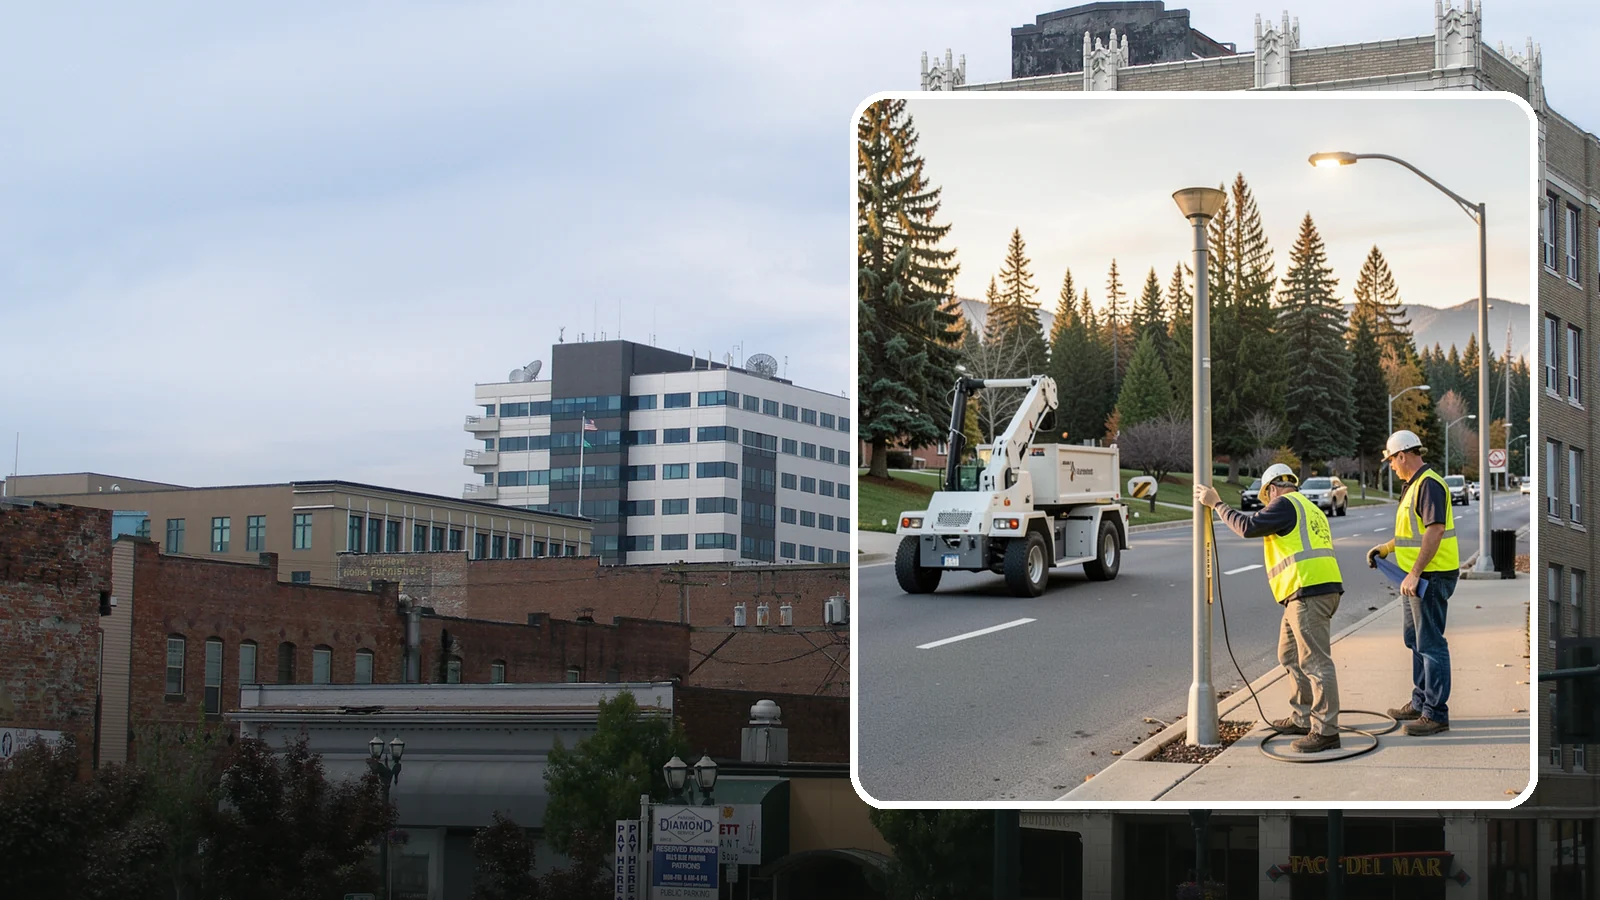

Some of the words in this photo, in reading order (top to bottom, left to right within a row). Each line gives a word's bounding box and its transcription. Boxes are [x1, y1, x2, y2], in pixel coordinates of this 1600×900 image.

[343, 567, 368, 577] Home
[370, 566, 427, 577] Furnishers
[660, 818, 713, 833] DIAMOND
[1022, 815, 1070, 828] BUILDING
[719, 823, 740, 836] ETT
[617, 825, 625, 853] PAY
[628, 824, 637, 853] PAY
[655, 845, 688, 853] RESERVED
[689, 846, 716, 854] PARKING
[721, 851, 739, 862] Soup
[671, 862, 701, 870] PATRONS
[1346, 856, 1384, 876] DEL
[1392, 857, 1443, 877] MAR
[616, 856, 625, 894] HERE
[627, 856, 637, 894] HERE
[660, 889, 682, 897] PUBLIC
[683, 890, 710, 898] PARKING
